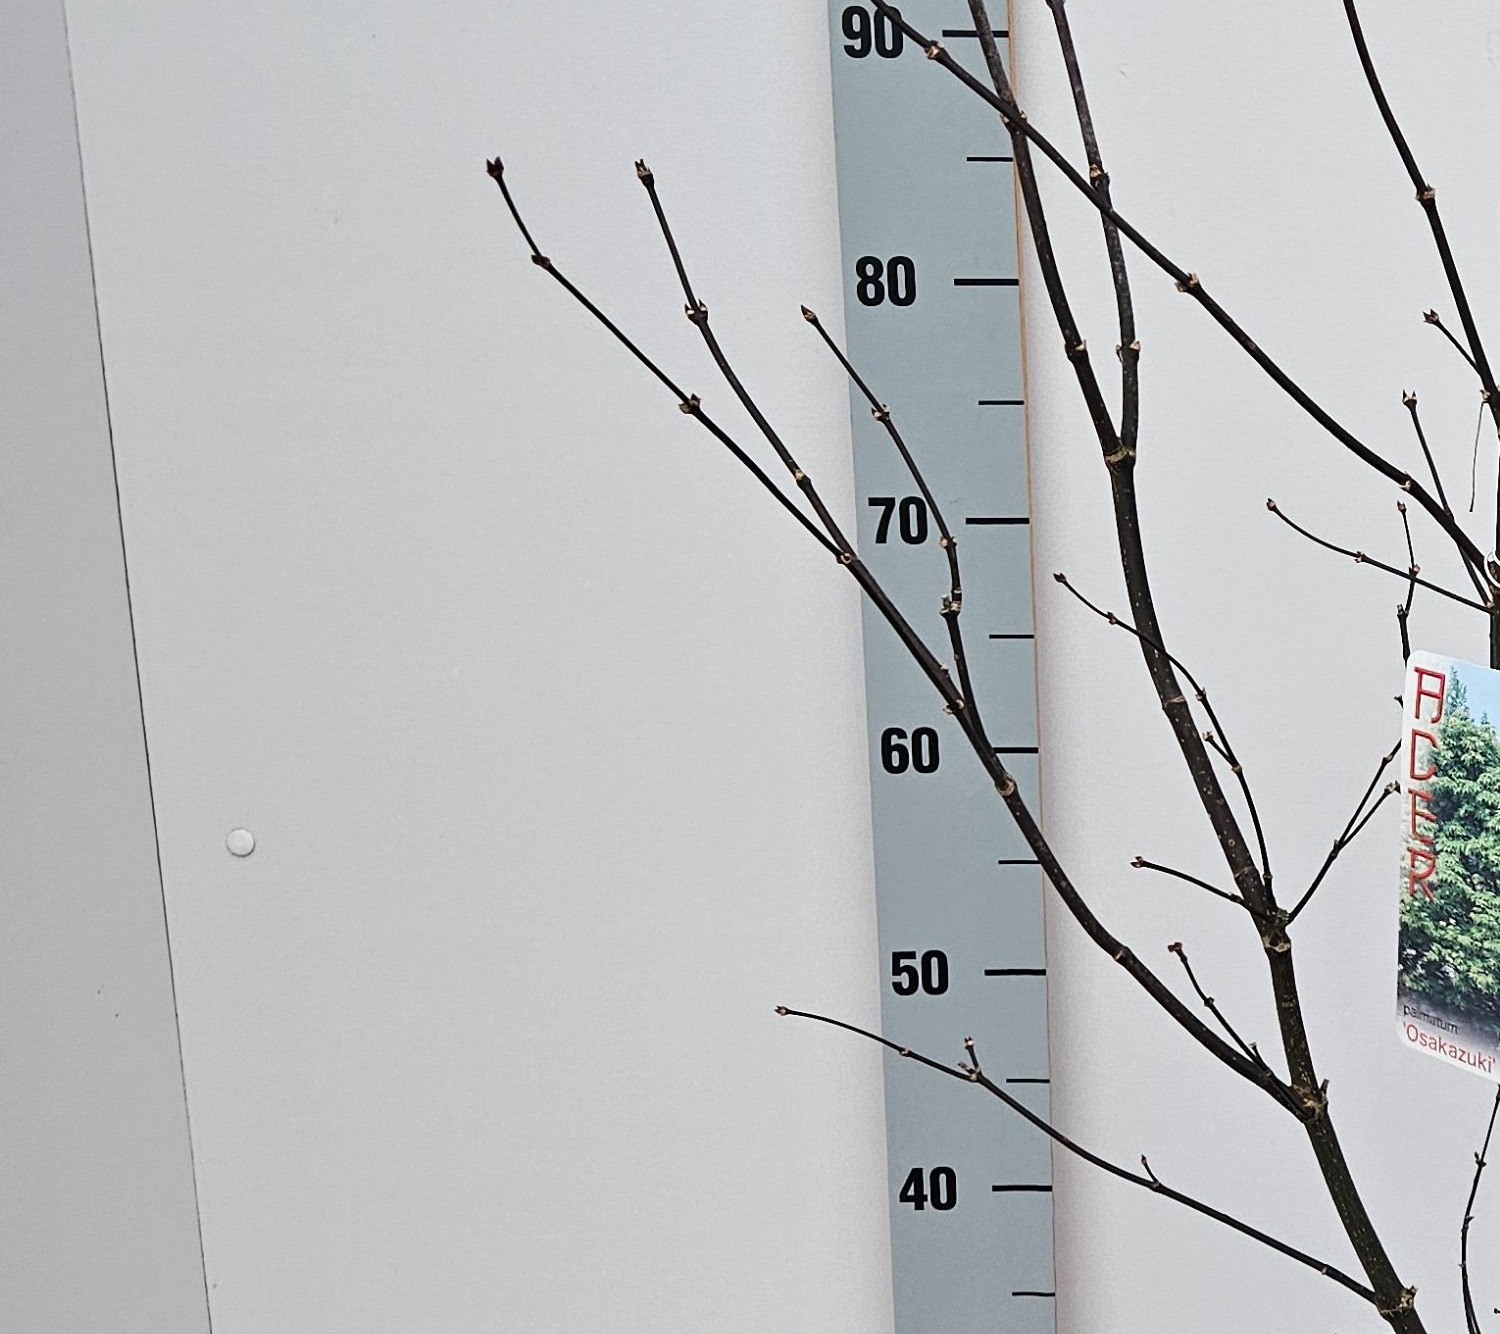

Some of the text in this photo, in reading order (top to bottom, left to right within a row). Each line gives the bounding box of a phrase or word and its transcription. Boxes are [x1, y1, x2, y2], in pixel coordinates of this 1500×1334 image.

[841, 5, 903, 59] 90
[856, 255, 917, 307] 80
[868, 497, 928, 545] 70
[882, 727, 940, 775] 60
[1407, 666, 1446, 904] ACER
[892, 950, 949, 996] 50
[1403, 1021, 1496, 1074] 'Osakazuki'
[900, 1167, 957, 1211] 40
